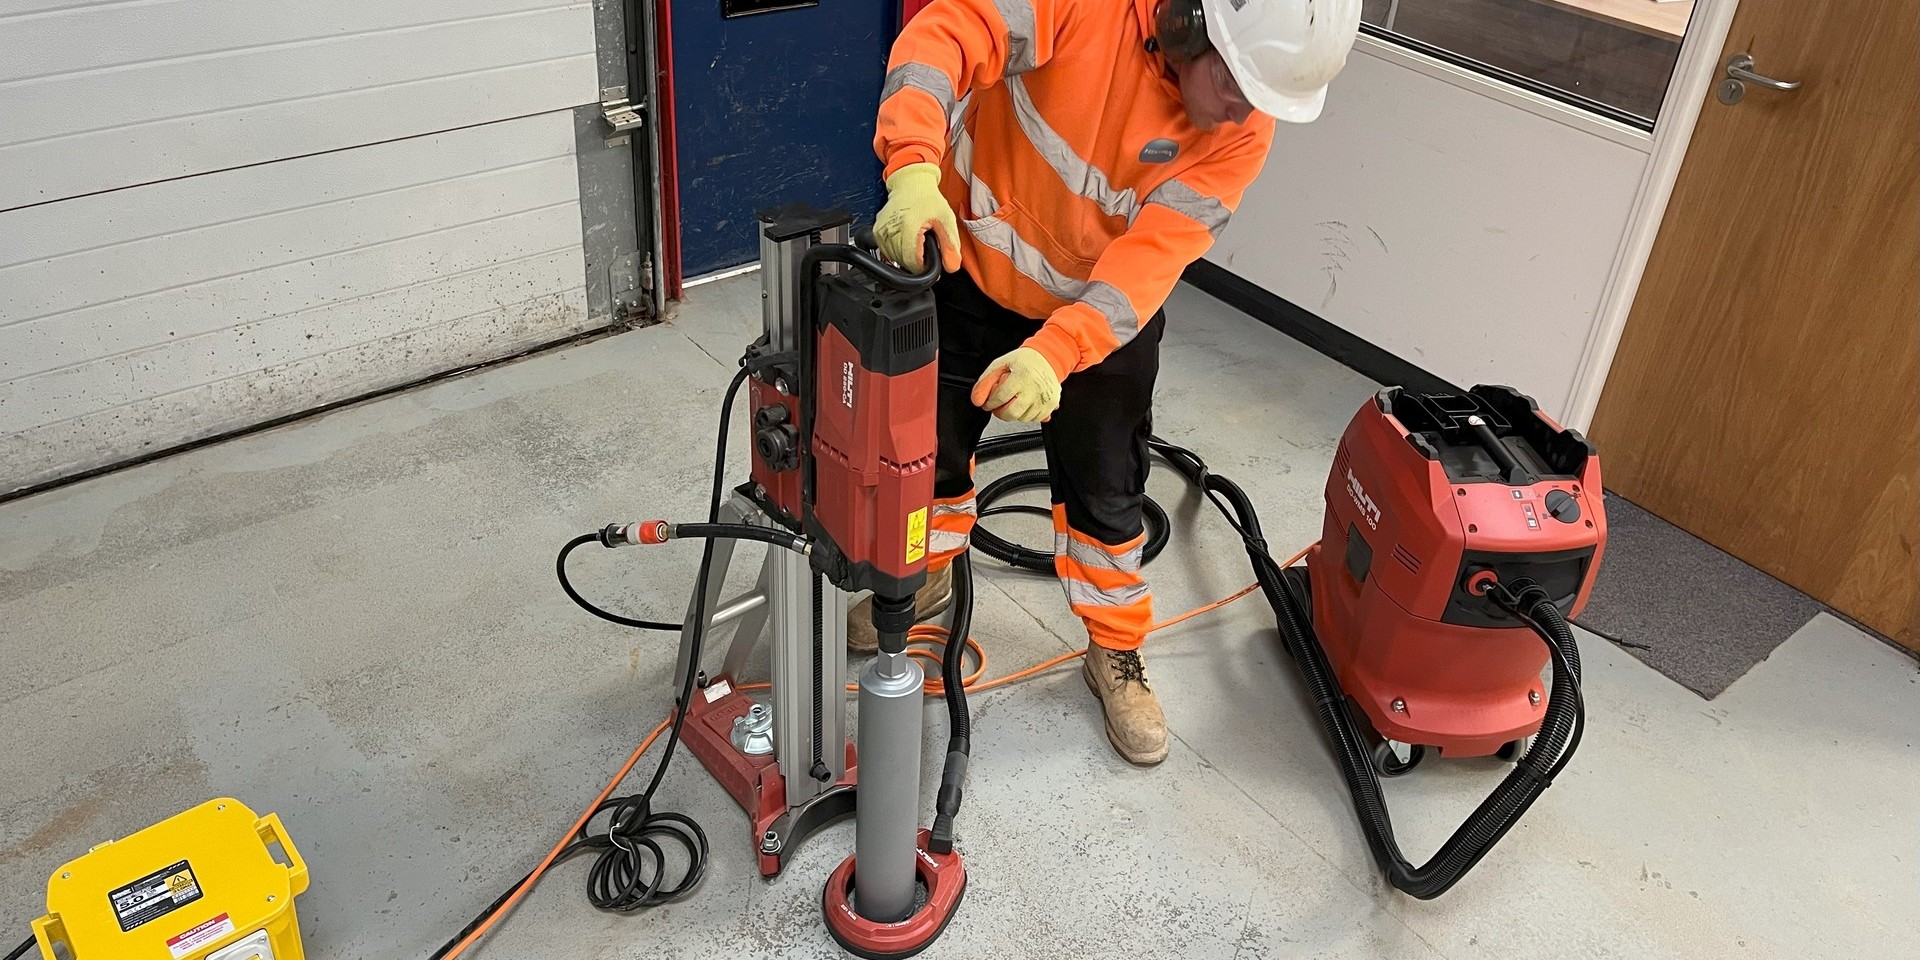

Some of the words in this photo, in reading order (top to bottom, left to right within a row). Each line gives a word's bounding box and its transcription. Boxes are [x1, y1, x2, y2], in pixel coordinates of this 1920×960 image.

[846, 361, 854, 408] HILTI
[1347, 467, 1381, 523] HILTI
[1366, 514, 1377, 531] 100
[915, 847, 939, 868] HILT
[179, 919, 216, 940] CAUTION
